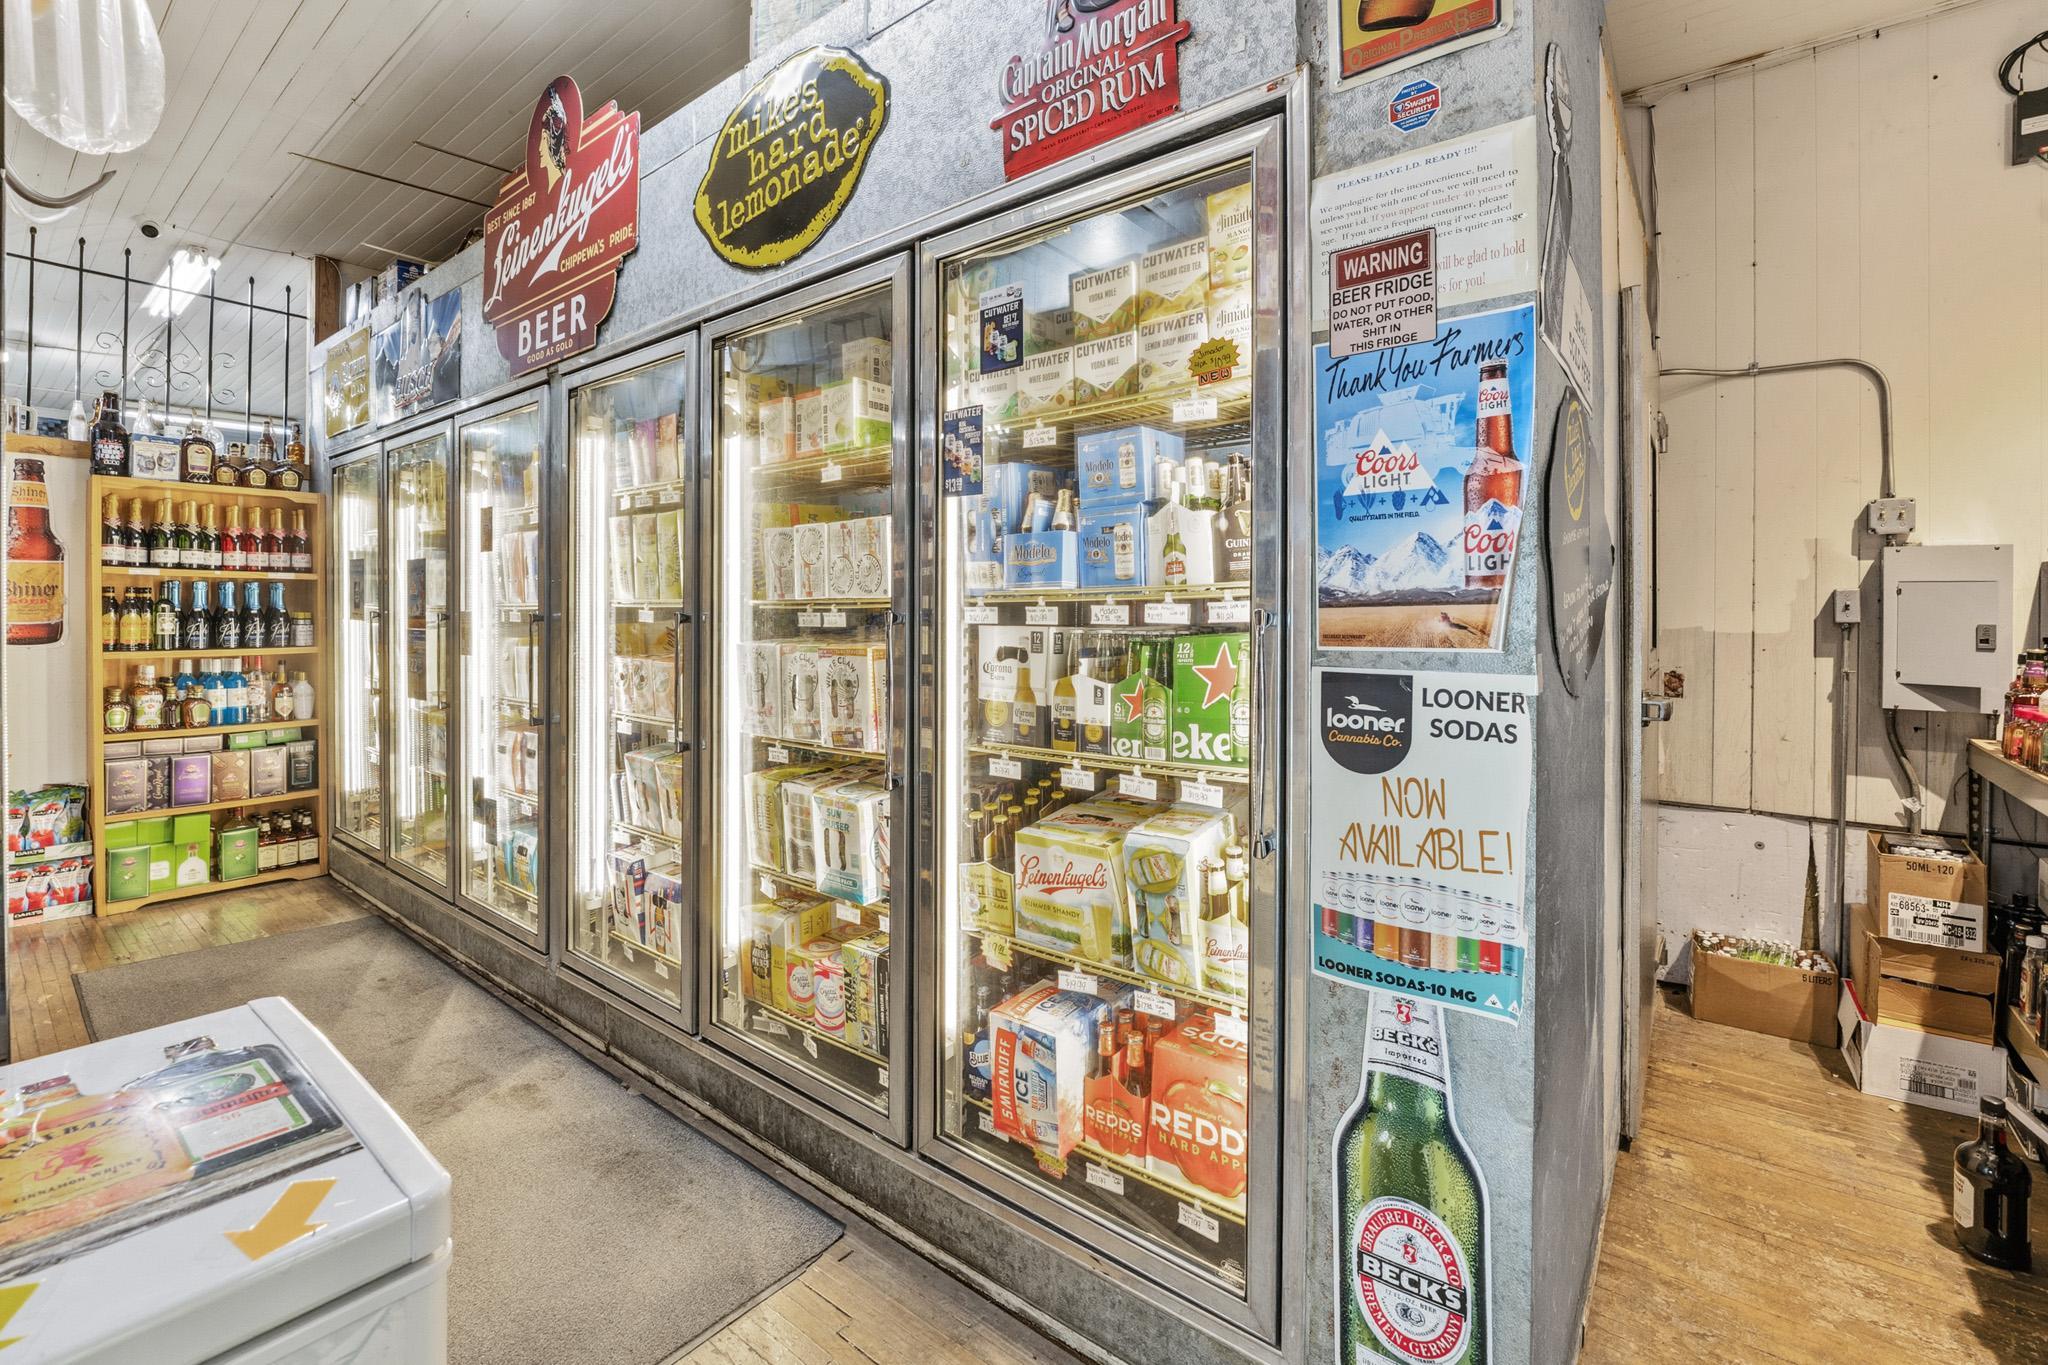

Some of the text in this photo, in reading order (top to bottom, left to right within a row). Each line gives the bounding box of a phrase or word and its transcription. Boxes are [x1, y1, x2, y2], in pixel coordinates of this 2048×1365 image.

[1002, 0, 1167, 104] Captain Morgan
[1348, 7, 1490, 70] ORIGINAL PREMIUM BEER
[1042, 51, 1125, 103] ORIGINAL
[1011, 52, 1166, 152] SPICED RUM
[1397, 103, 1432, 119] SECURITY
[1404, 94, 1436, 110] Swann
[748, 99, 828, 185] hard
[1336, 150, 1461, 191] PLEASE HAVE READY
[1320, 206, 1333, 215] We
[1335, 195, 1374, 212] apologize
[1376, 191, 1388, 200] for
[1390, 187, 1405, 196] the
[1477, 162, 1493, 173] but
[1320, 214, 1344, 225] unless
[1346, 209, 1361, 220] you
[1363, 204, 1378, 214] live
[1381, 199, 1399, 209] with
[1401, 195, 1418, 203] one
[1420, 189, 1430, 197] of
[1462, 177, 1479, 187] will
[1481, 170, 1505, 183] need
[1508, 168, 1518, 177] to
[487, 191, 537, 234] BEST SINCE 1867
[1334, 222, 1354, 232] your
[1380, 210, 1397, 220] you
[1399, 202, 1429, 215] appear
[1433, 194, 1460, 205] under
[1464, 189, 1475, 198] 40
[1478, 183, 1503, 195] years
[1505, 179, 1517, 188] of
[1350, 229, 1366, 240] you
[1392, 214, 1429, 229] frequent
[1479, 193, 1509, 207] please
[1455, 203, 1512, 226] if we carded
[1455, 226, 1463, 235] is
[1465, 221, 1489, 234] quite
[1491, 218, 1504, 226] an
[1506, 212, 1524, 223] age
[560, 238, 605, 273] CHIPPEWA'S
[1142, 241, 1205, 270] CUTWATER
[1343, 242, 1424, 280] WARNING
[1453, 238, 1526, 269] be glad to hold
[1074, 265, 1131, 293] CUTWATER
[1332, 285, 1371, 307] BEER
[1374, 272, 1433, 298] FRIDGE
[1449, 276, 1462, 292] for
[1465, 272, 1487, 294] you!
[984, 301, 1019, 318] CUTWATER
[1333, 292, 1434, 320] DO NOT PUT FOOD,
[1333, 304, 1433, 332] WATER, OR OTHER
[518, 293, 588, 357] BEER
[1141, 312, 1204, 338] CUTWATER
[1362, 322, 1401, 338] SHIT IN
[526, 338, 573, 363] GOOD AS GOLD
[1077, 334, 1133, 359] CUTWATER
[1350, 332, 1418, 352] THIS FRIDGE
[1200, 367, 1232, 385] NEW
[1325, 355, 1388, 404] Thank
[1388, 348, 1427, 390] You
[1430, 327, 1525, 377] Farmers
[1479, 388, 1509, 404] Coors
[1480, 399, 1508, 411] LIGHT
[944, 408, 981, 421] CUTWATER
[1085, 459, 1114, 474] Modelo
[1355, 447, 1420, 476] Coors
[1363, 472, 1411, 490] LIGHT
[1014, 544, 1051, 561] Modelo
[1083, 537, 1111, 549] Modelo
[1033, 632, 1041, 643] 12
[1055, 634, 1062, 643] 12
[1178, 642, 1192, 654] 12
[983, 661, 1013, 675] Corona
[1114, 702, 1122, 713] 6
[1422, 687, 1525, 715] LOONER
[1326, 707, 1405, 733] looner
[1430, 718, 1517, 745] SODAS
[1328, 730, 1403, 748] Cannabis Co.
[1381, 776, 1446, 820] NOW
[1338, 822, 1514, 876] AVAILABLE!
[1052, 905, 1080, 919] SHANDY
[1319, 955, 1373, 987] LOONER
[1450, 985, 1478, 1004] MG
[1810, 974, 1833, 986] LITERS
[1373, 1028, 1440, 1057] BECK'S
[969, 1051, 990, 1068] BLUE
[998, 1038, 1014, 1120] SMIRNOFF
[1016, 1068, 1029, 1104] ICE
[1085, 1105, 1142, 1138] REDD'S
[1159, 1132, 1200, 1156] HARD
[1362, 1210, 1409, 1252] BRAUEREI
[1412, 1216, 1449, 1254] BECK
[1442, 1254, 1454, 1264] &
[1362, 1252, 1462, 1311] BECK'S
[1446, 1265, 1461, 1286] CO
[1362, 1279, 1404, 1344] BREMEN
[1408, 1315, 1462, 1358] GERMANY
